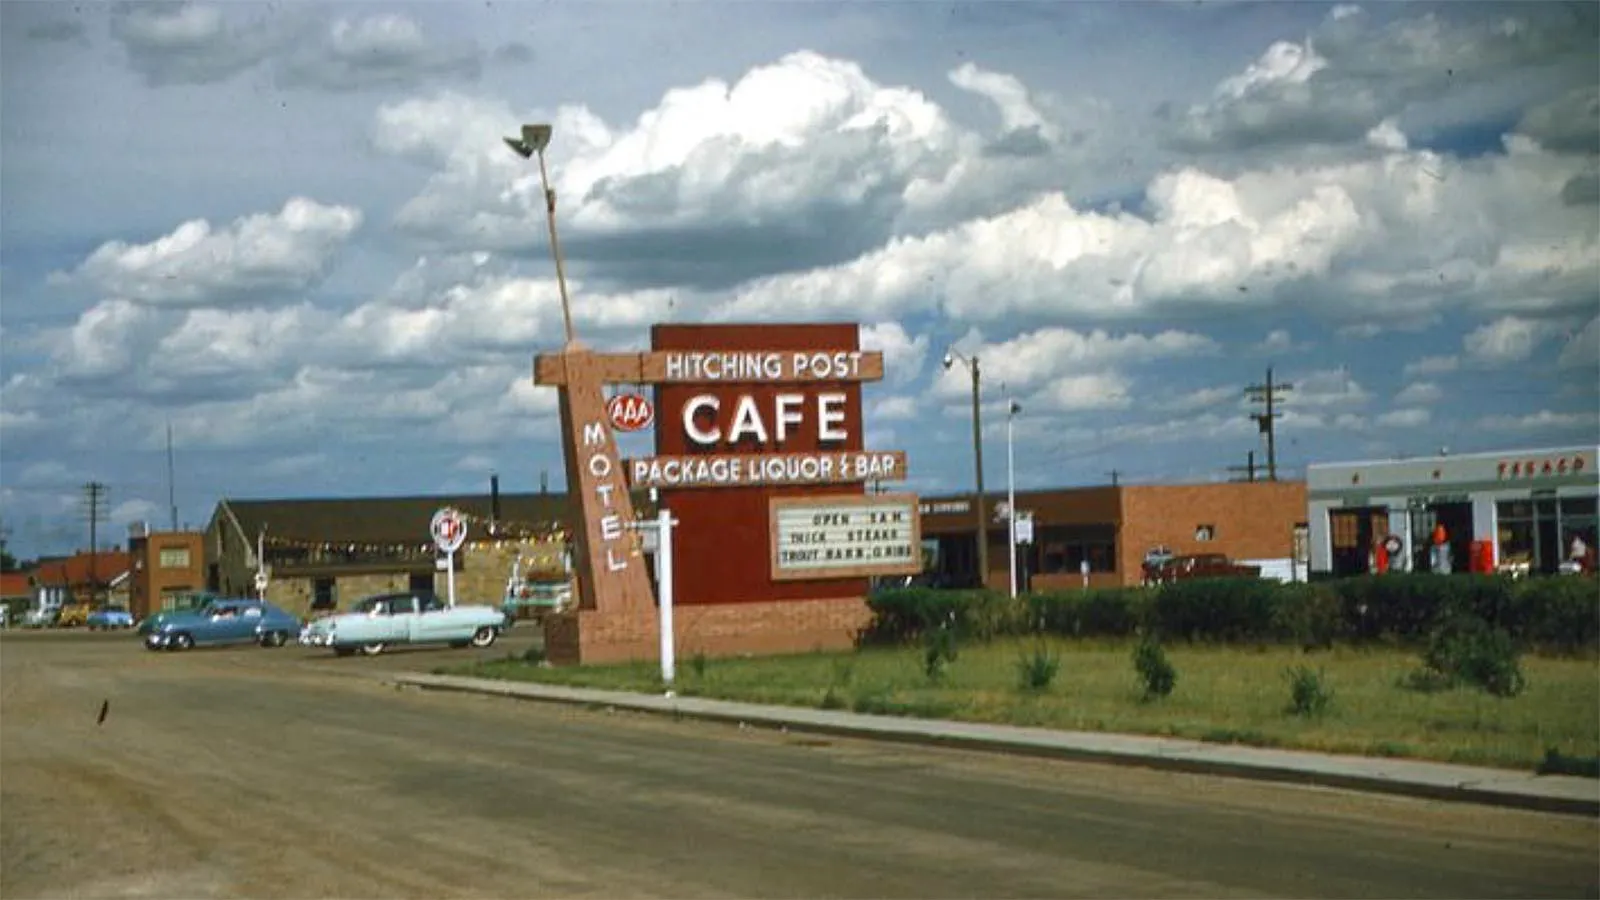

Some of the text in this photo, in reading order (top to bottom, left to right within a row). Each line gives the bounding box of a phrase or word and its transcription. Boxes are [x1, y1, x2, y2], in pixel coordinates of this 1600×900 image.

[666, 351, 862, 380] HITCHING POST
[612, 398, 648, 423] AAA
[683, 393, 848, 443] CAFE
[635, 458, 741, 482] PACKAGE
[749, 455, 833, 480] LIQUOR
[855, 453, 895, 477] BAR
[583, 422, 627, 571] MOTEL
[812, 513, 849, 526] OPEN
